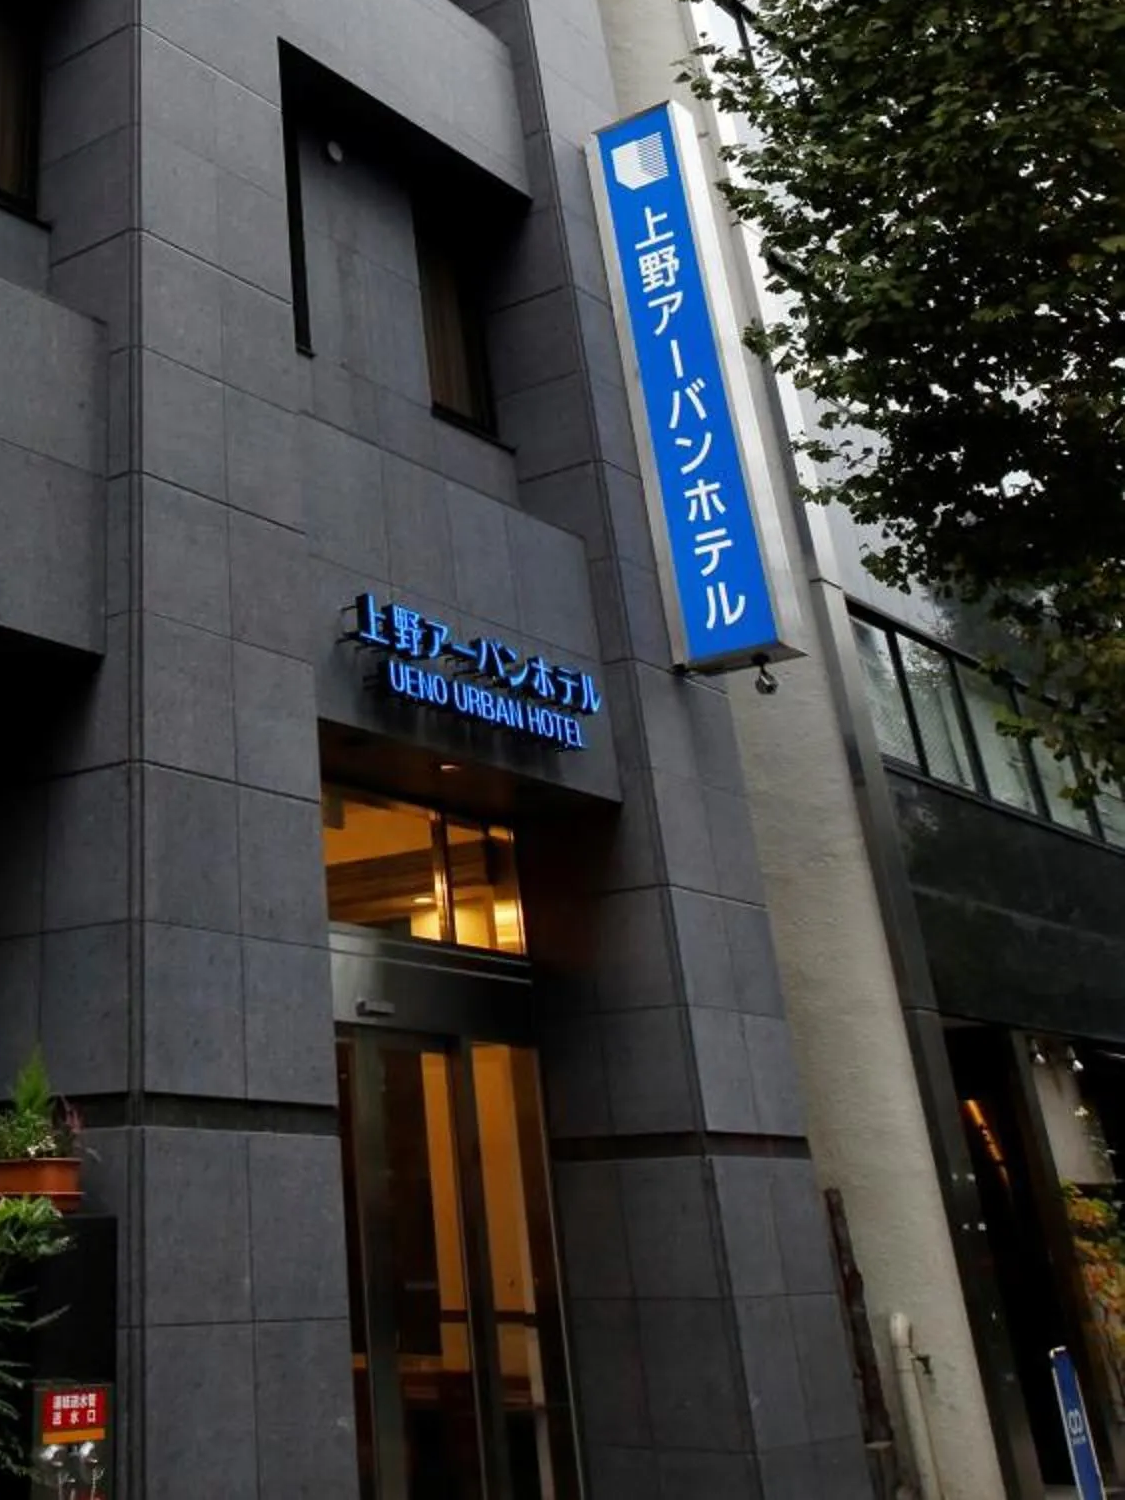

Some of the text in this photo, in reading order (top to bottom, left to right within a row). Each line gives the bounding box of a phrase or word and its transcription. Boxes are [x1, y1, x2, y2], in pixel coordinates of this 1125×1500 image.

[634, 207, 745, 630] 上野アーバンホテル
[359, 593, 602, 712] 上野アーバンホテル
[388, 660, 584, 748] UENO URBAN HOTEL
